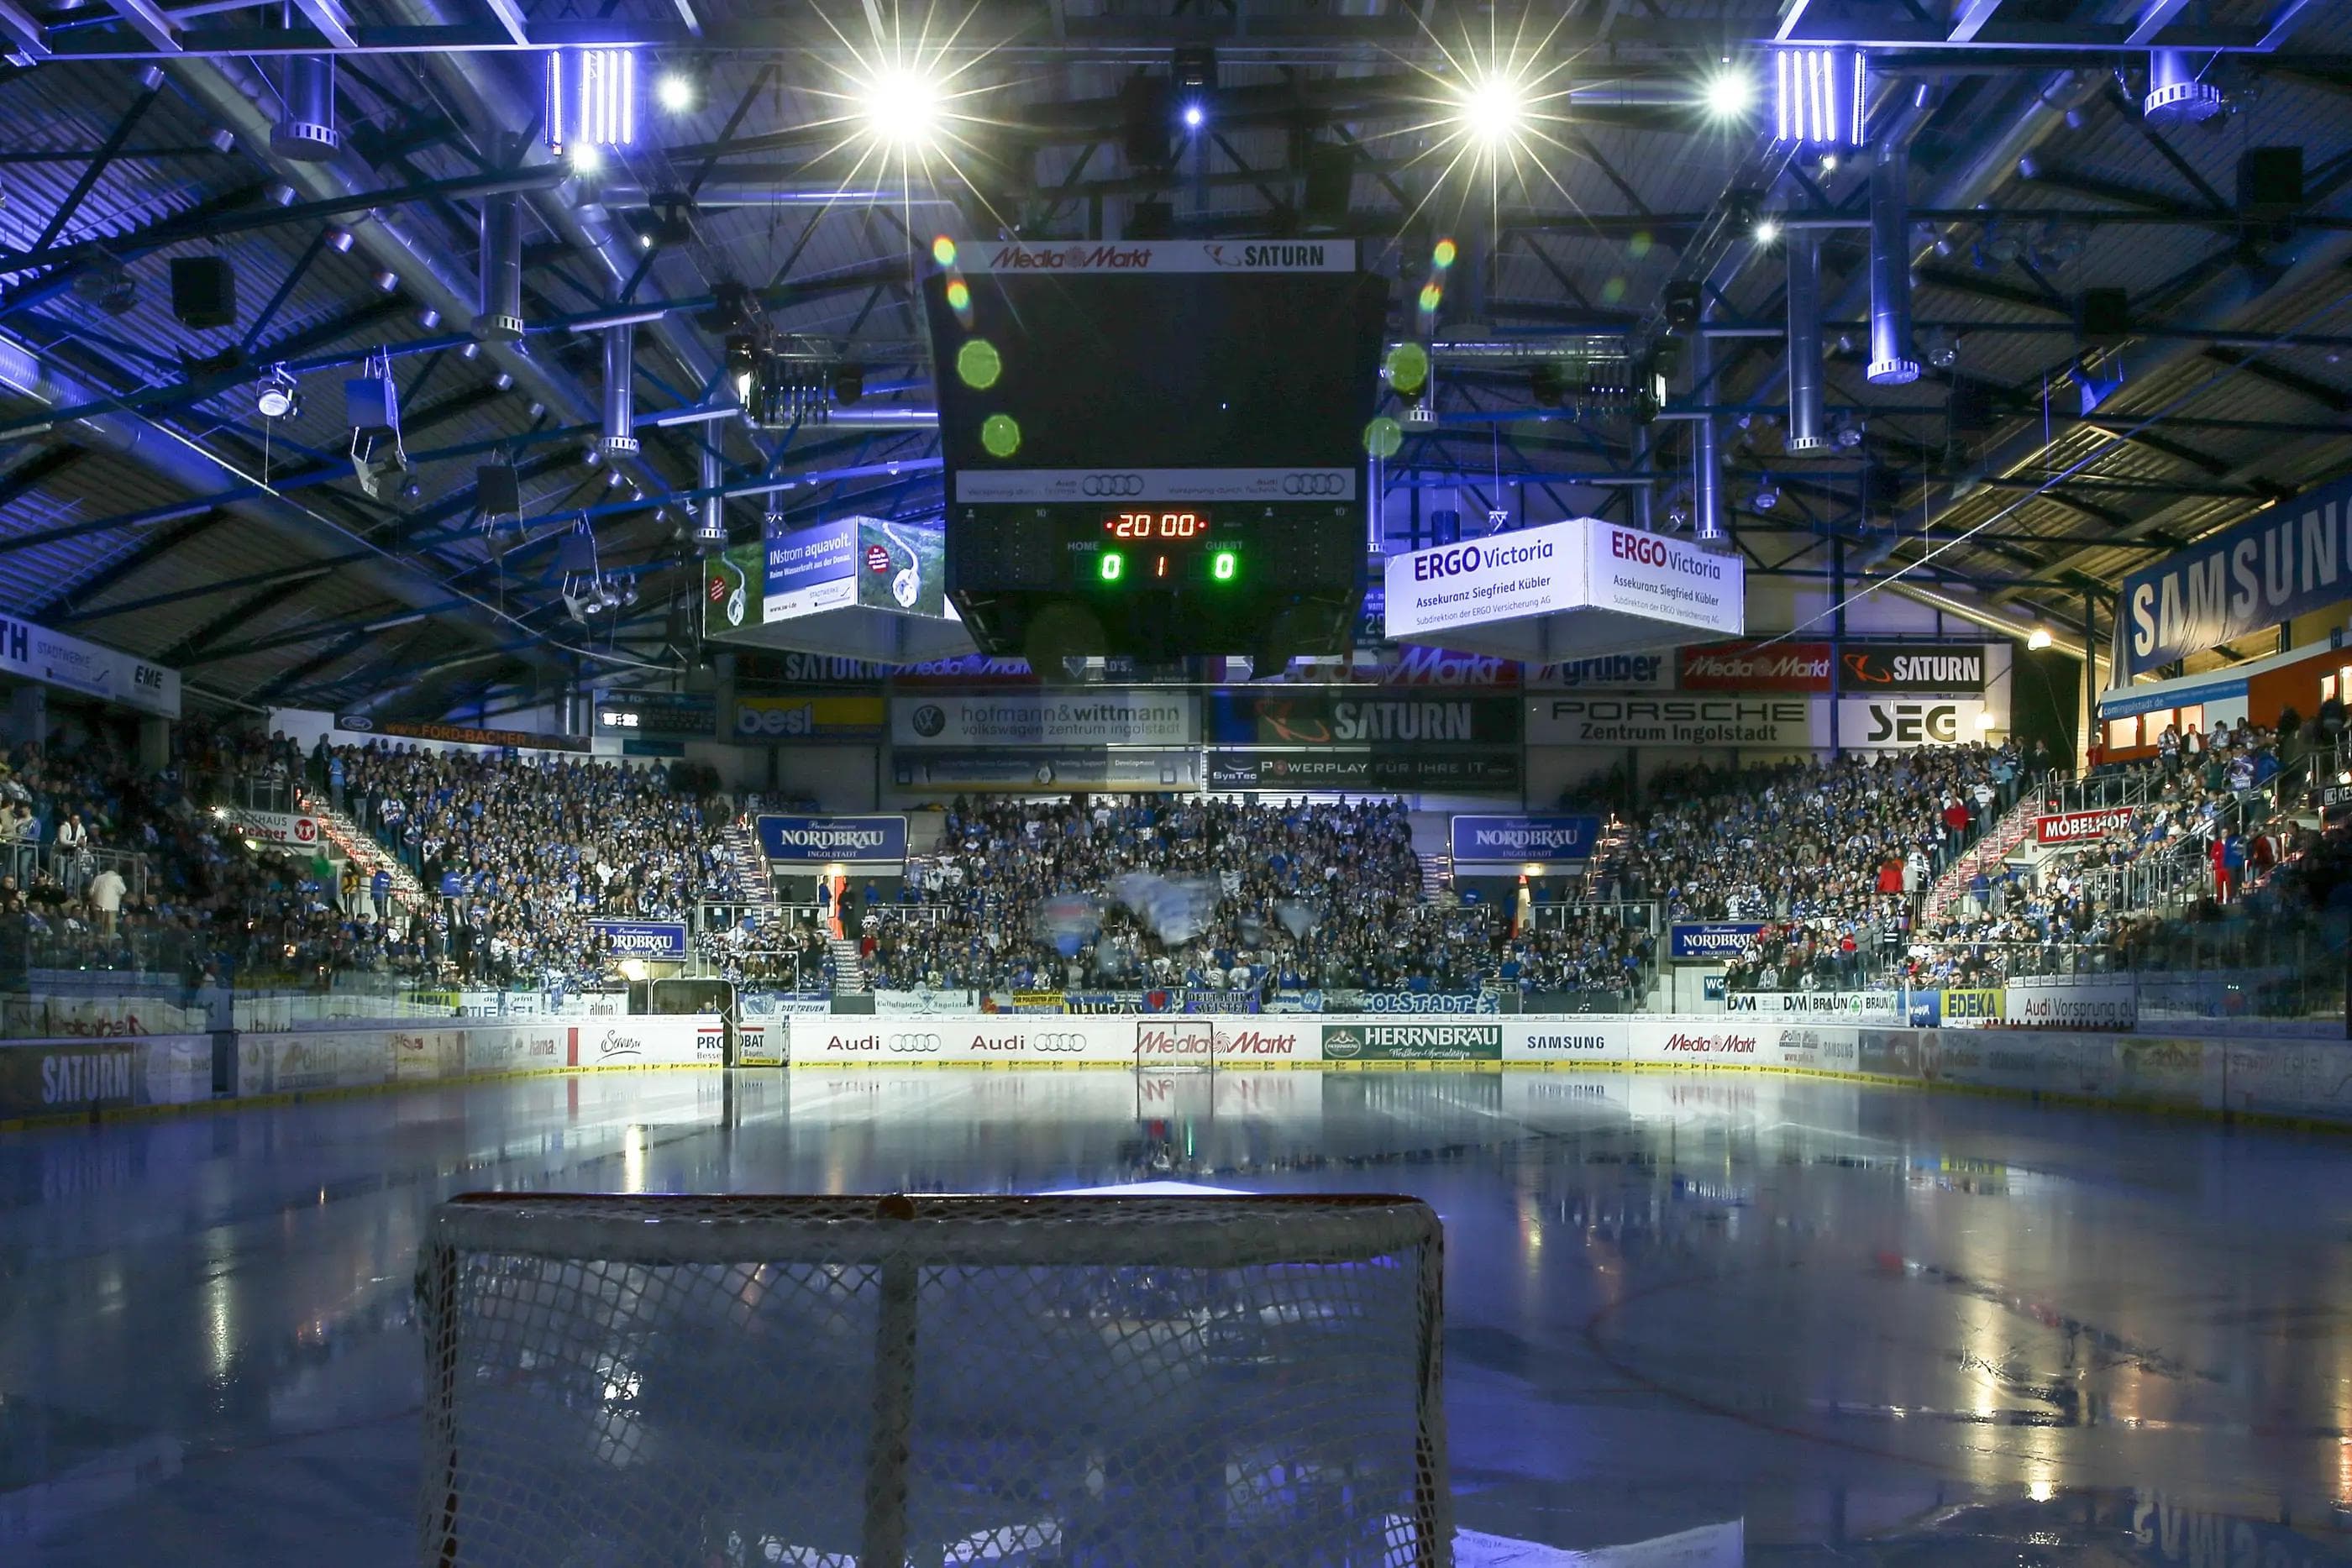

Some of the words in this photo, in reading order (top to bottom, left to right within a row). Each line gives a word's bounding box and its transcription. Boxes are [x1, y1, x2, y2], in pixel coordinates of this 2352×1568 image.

[989, 245, 1064, 269] Media
[1083, 247, 1152, 269] Markt
[1245, 245, 1324, 267] SATURN
[769, 547, 803, 566] INstrom
[804, 532, 852, 558] aquavolt.
[1067, 540, 1100, 551] HOME
[1205, 539, 1243, 551] GUEST
[1612, 530, 1667, 568] ERGO
[1669, 551, 1721, 580] Victoria
[1102, 553, 1121, 579] 0
[1158, 556, 1165, 576] 1
[1215, 552, 1235, 579] 0
[1414, 545, 1481, 582] ERGO
[1483, 539, 1553, 569] Victoria
[2133, 496, 2352, 658] SAMSUN
[1416, 590, 1470, 608] Assekuranz
[1473, 582, 1515, 604] Siegfried
[1518, 575, 1551, 592] Kübler
[1613, 574, 1658, 595] Assekuranz
[1660, 583, 1693, 605] Siegfried
[1694, 589, 1719, 606] Kübler
[1416, 610, 1457, 627] Subdirektion
[1459, 607, 1471, 619] der
[1472, 603, 1492, 617] ERGO
[1493, 597, 1539, 614] Versicherung
[1541, 595, 1551, 606] AG
[1660, 602, 1675, 615] ERGO
[135, 665, 163, 690] EME
[1684, 655, 1753, 678] Media
[1767, 656, 1831, 679] Markt
[1893, 655, 1980, 682] SATURN
[1334, 700, 1472, 741] SATURN
[1551, 701, 1805, 722] PORSCHE
[961, 723, 1043, 739] volkswagen
[1048, 722, 1105, 736] zentrum
[1110, 722, 1181, 738] ingolstadt
[1580, 723, 1667, 742] Zentrum
[1673, 723, 1777, 744] Ingolstadt
[1867, 705, 1956, 742] SEG
[1376, 759, 1410, 774] FÜR
[1417, 761, 1460, 774] IHRE
[1467, 761, 1485, 774] IT
[2045, 813, 2129, 838] MÖBELHOF
[781, 829, 885, 849] NORDBRÄU
[1476, 829, 1578, 848] NORDBRÄU
[807, 850, 858, 858] INGOLSTADT
[1706, 978, 1724, 989] WC
[782, 1004, 794, 1013] DIE
[1727, 996, 1756, 1011] DVM
[1783, 995, 1807, 1011] DVM
[1866, 996, 1888, 1009] BRAUN
[1948, 993, 1997, 1018] EDEKA
[2024, 998, 2050, 1017] Audi
[2053, 998, 2115, 1020] Vorsprung
[827, 1035, 879, 1051] Audi
[970, 1035, 1025, 1051] Audi
[1132, 1030, 1211, 1054] Media
[1226, 1030, 1296, 1054] Markt
[1365, 1026, 1498, 1046] HERRNBRÄU
[1527, 1036, 1605, 1049] SAMSUNG
[1663, 1033, 1711, 1052] Media
[1719, 1034, 1757, 1053] Markt
[1824, 1041, 1854, 1058] SAMSUNG
[40, 1051, 130, 1104] SATURN
